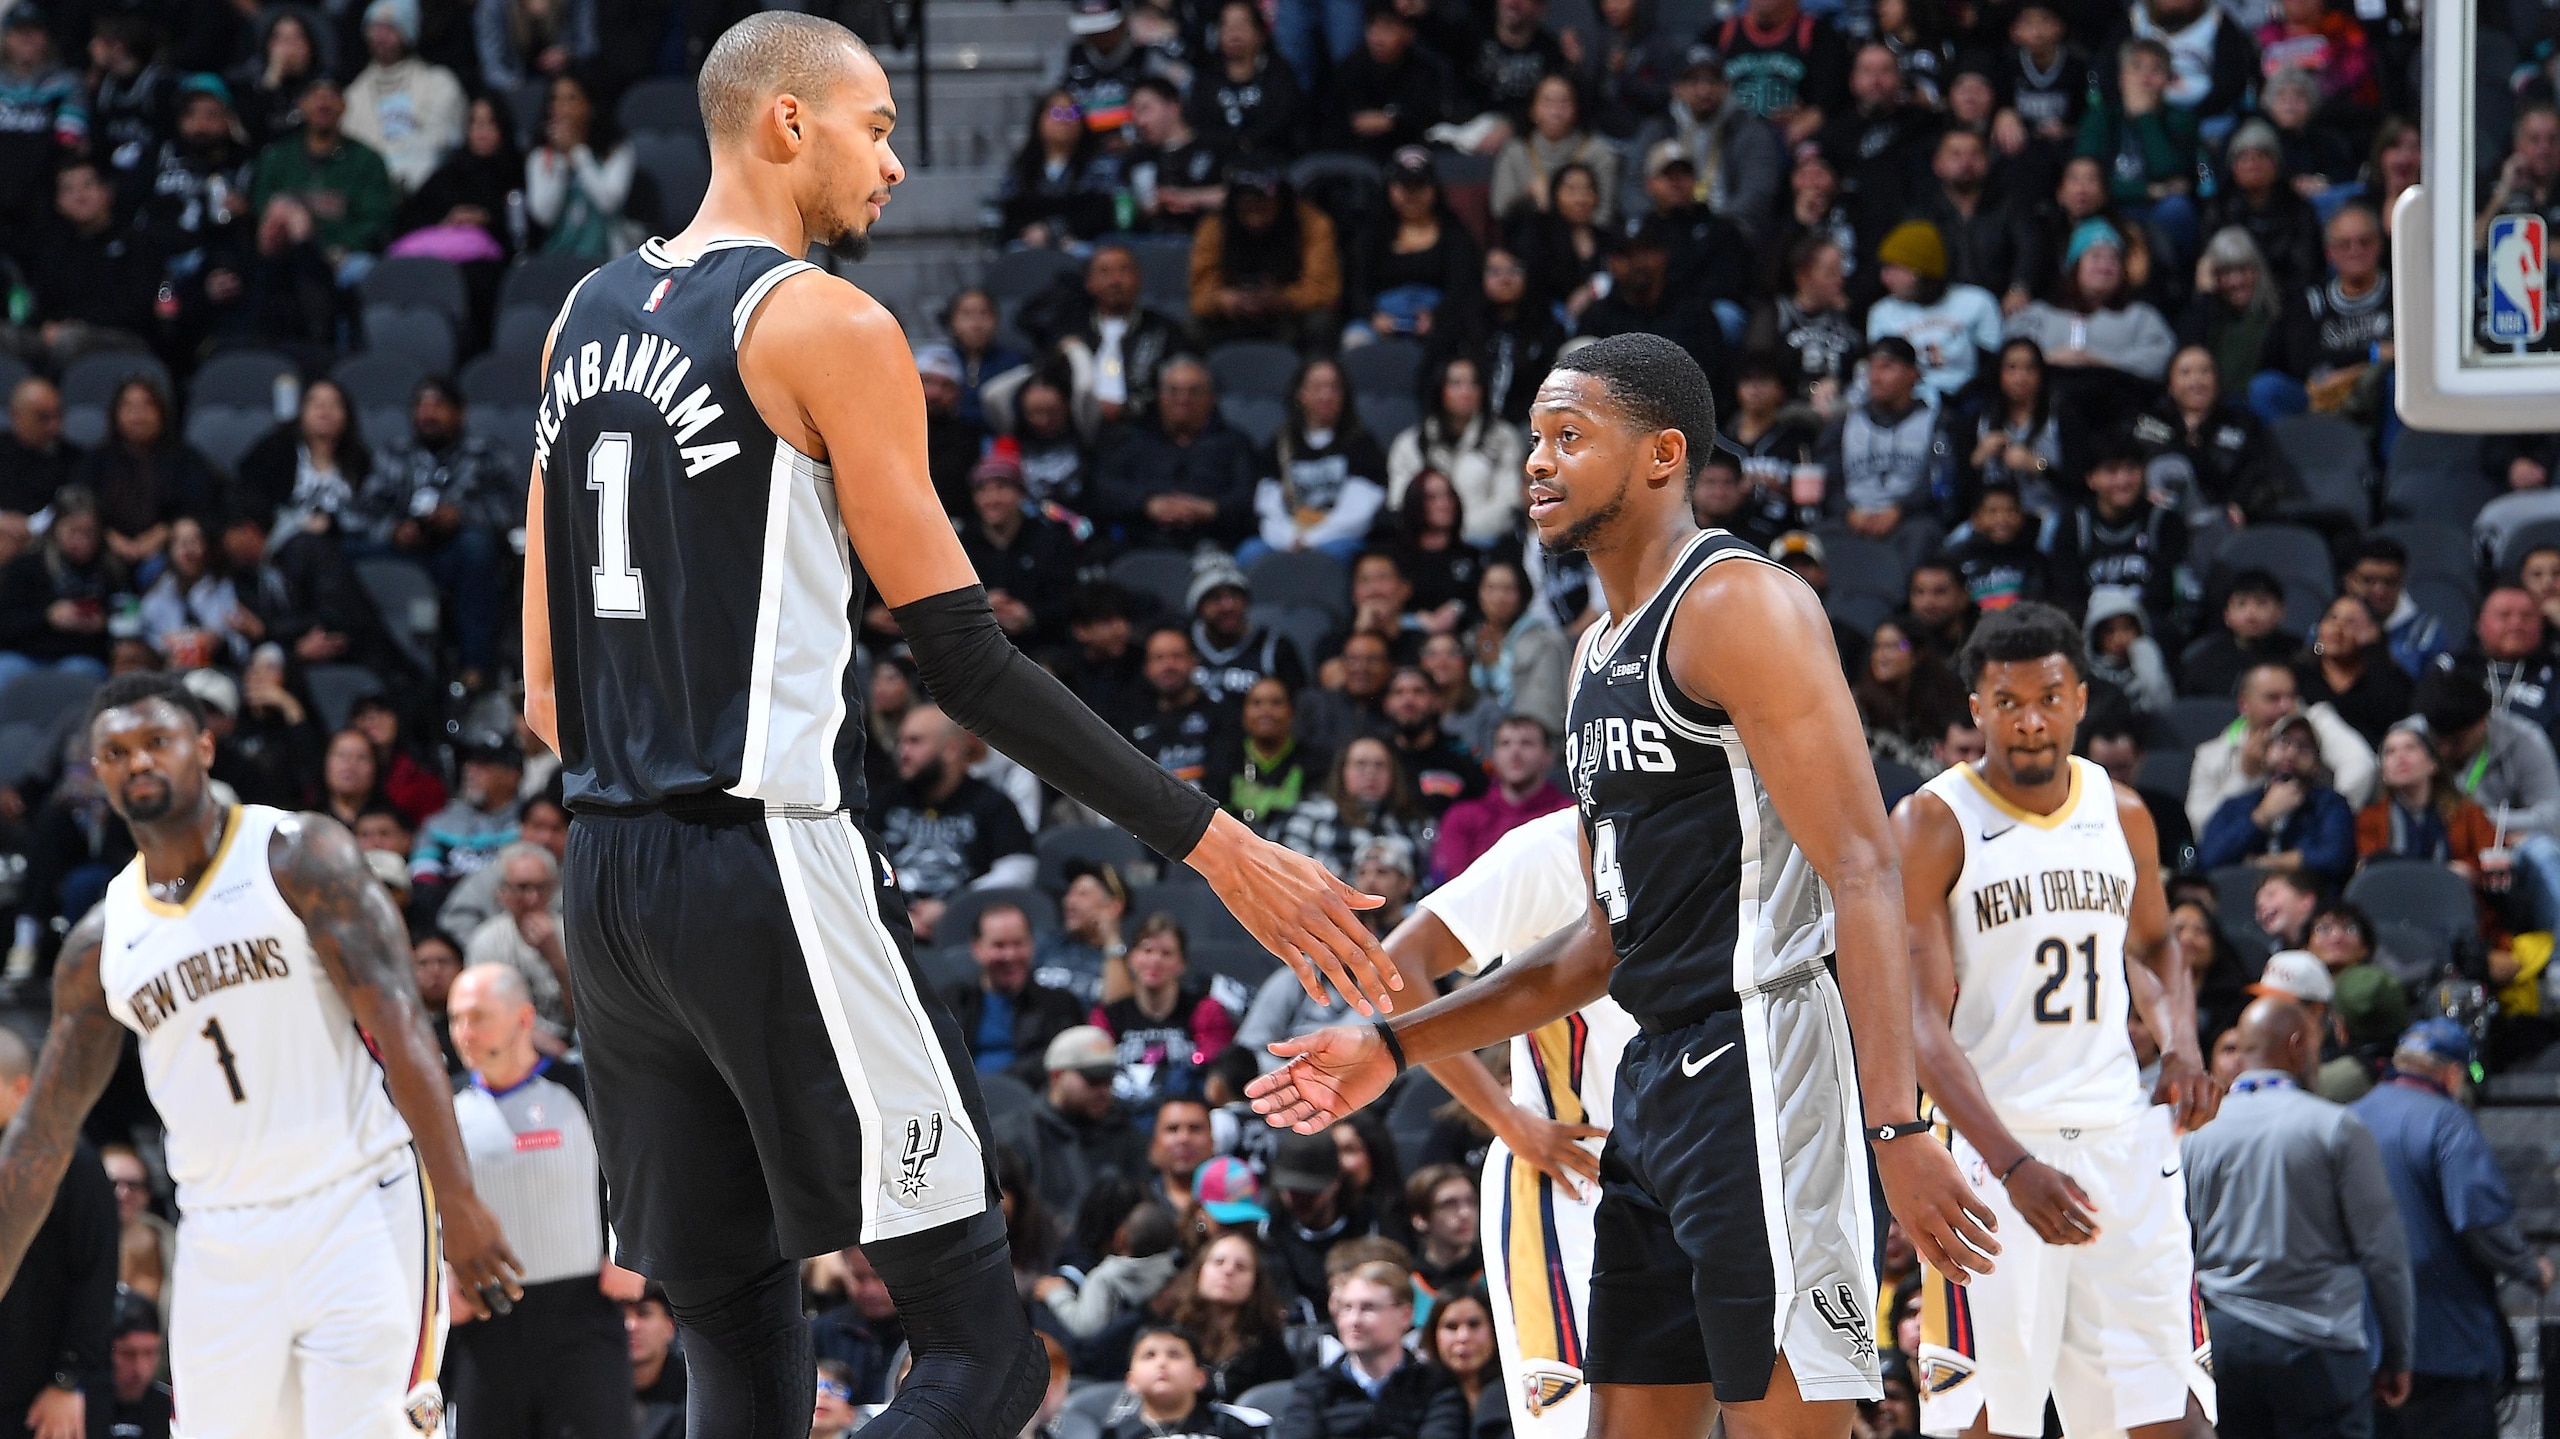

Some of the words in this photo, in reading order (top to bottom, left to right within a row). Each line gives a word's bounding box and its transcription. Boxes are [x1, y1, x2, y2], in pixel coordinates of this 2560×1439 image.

[535, 332, 740, 479] WEMBANYAMA
[585, 431, 646, 620] 1
[1612, 661, 1642, 678] LEDGER
[1565, 717, 1676, 793] PURS
[1593, 818, 1630, 924] 4
[1972, 875, 2033, 933] NEW
[176, 938, 290, 1003] ORLEANS
[2034, 933, 2101, 1025] 21
[200, 1014, 247, 1104] 1
